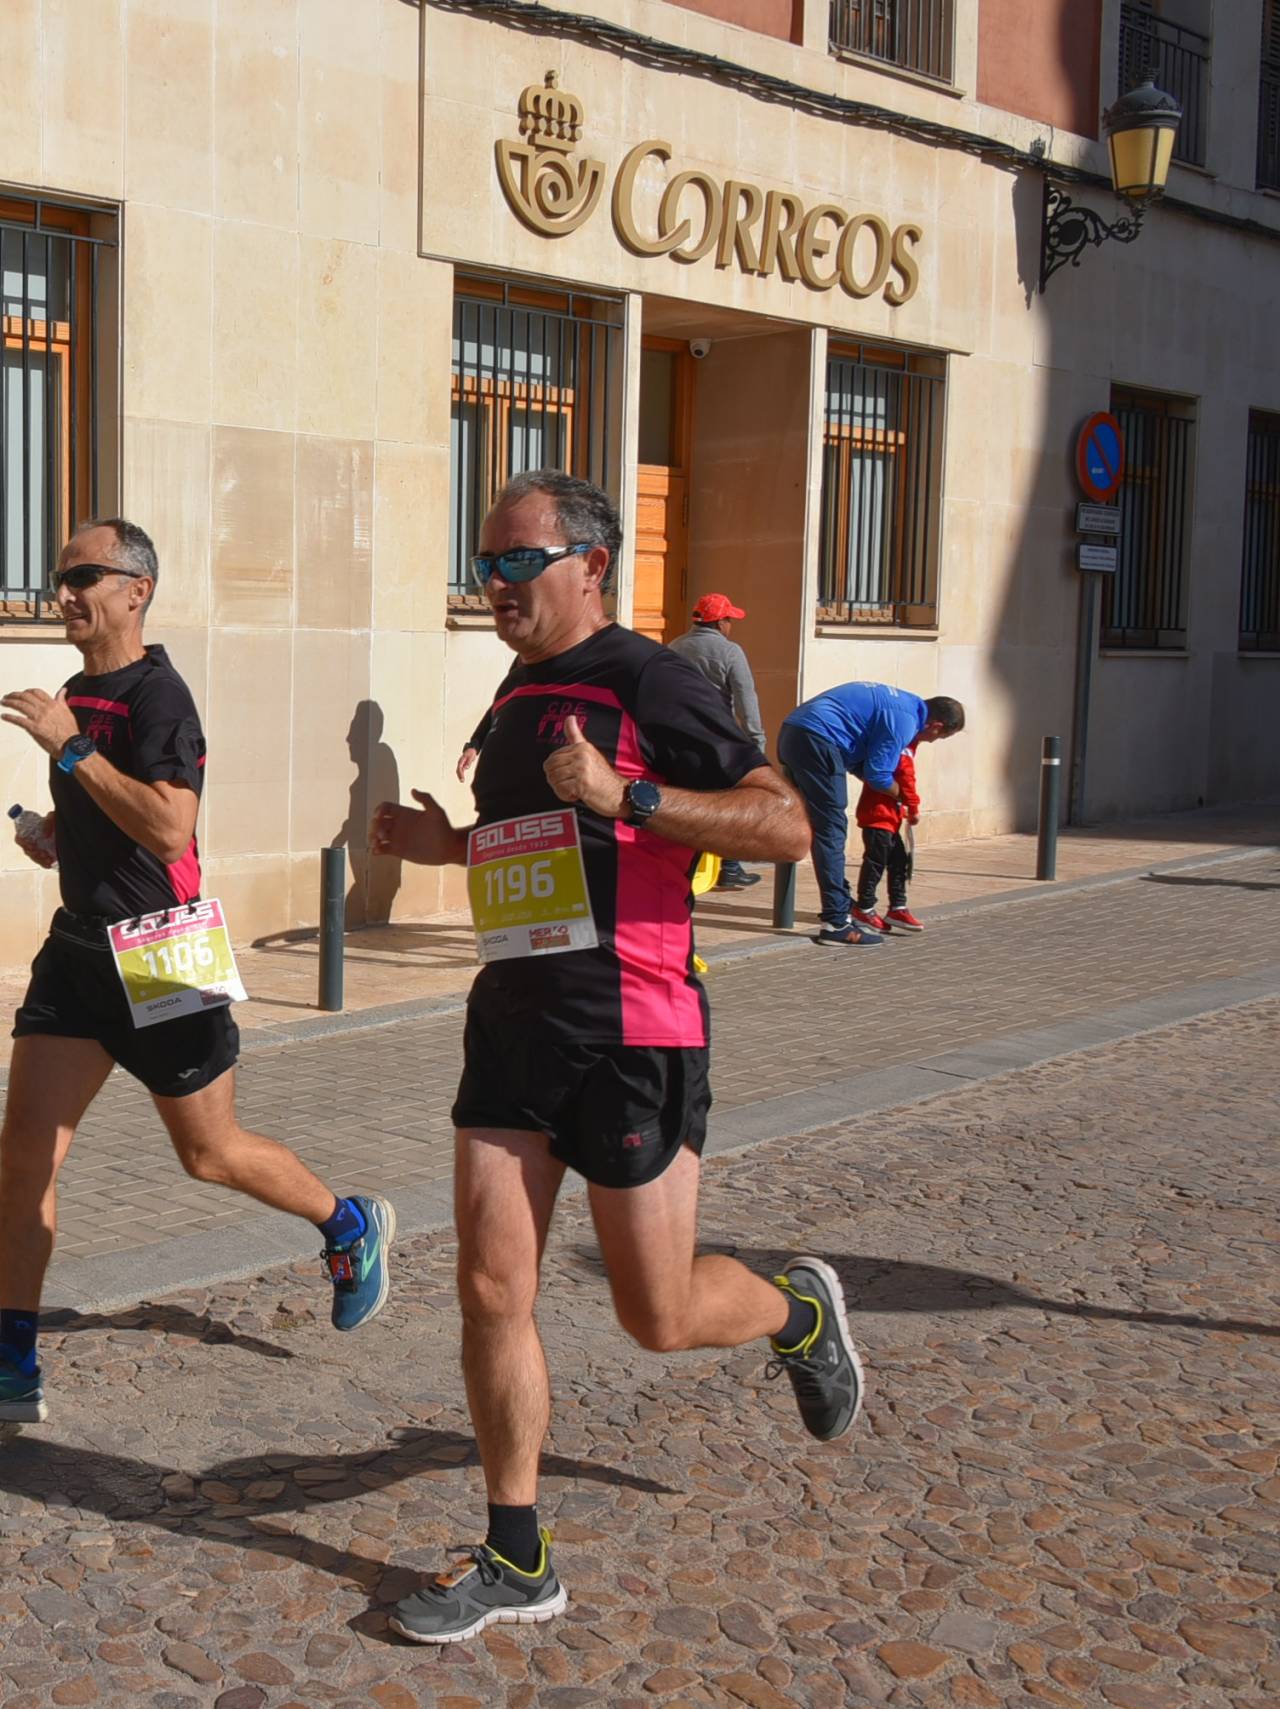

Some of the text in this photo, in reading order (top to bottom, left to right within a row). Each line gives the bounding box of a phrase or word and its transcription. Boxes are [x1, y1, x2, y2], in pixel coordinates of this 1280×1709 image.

[612, 139, 923, 306] CORREOS
[476, 815, 565, 852] SOLISS
[484, 859, 556, 907] 1196
[142, 935, 214, 979] 1106
